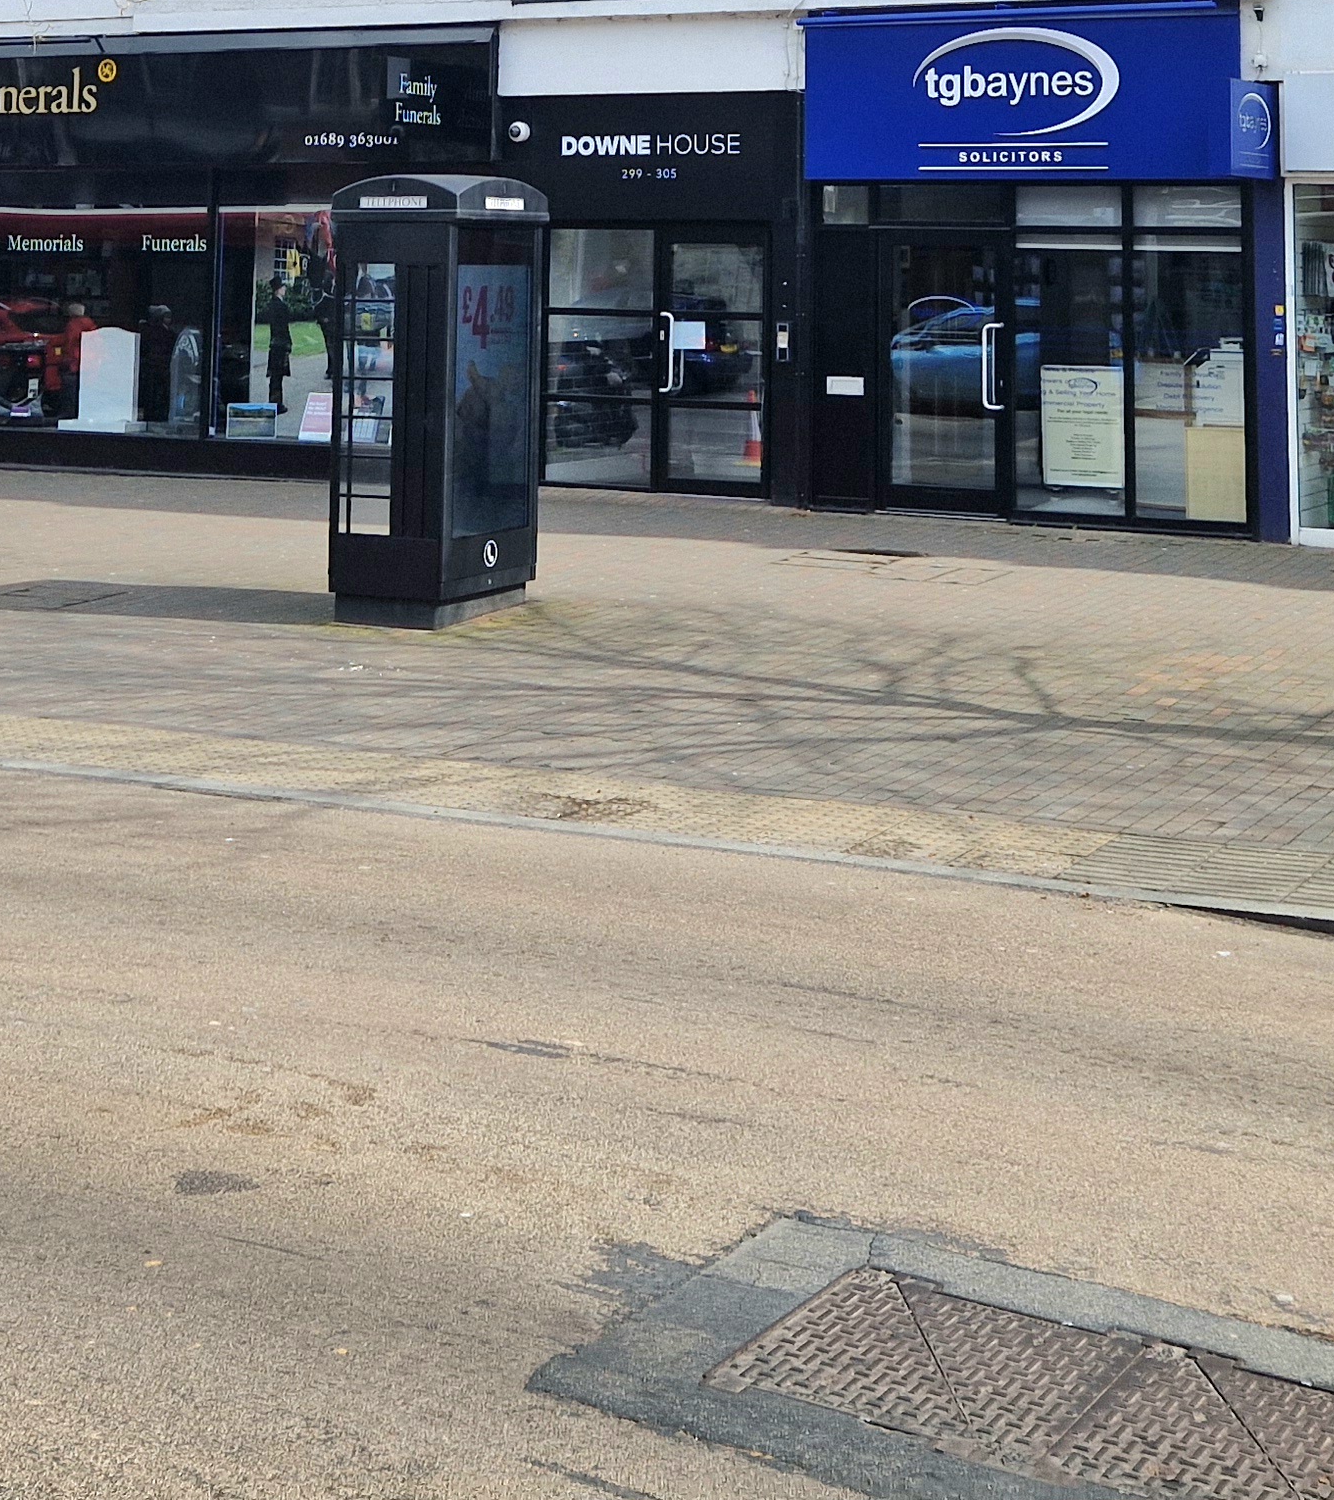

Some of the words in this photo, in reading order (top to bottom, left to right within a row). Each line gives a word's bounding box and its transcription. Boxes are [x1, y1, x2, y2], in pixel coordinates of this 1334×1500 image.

[399, 73, 438, 102] Family
[925, 65, 1094, 107] tgbaynes
[395, 102, 441, 125] Funerals
[304, 132, 345, 147] 01689
[560, 135, 651, 156] DOWNE
[656, 134, 741, 155] HOUSE
[958, 151, 1063, 162] SOLICITORS
[621, 168, 643, 179] 299
[655, 168, 677, 179] 305
[7, 234, 84, 251] Memorials
[141, 234, 207, 252] Funerals
